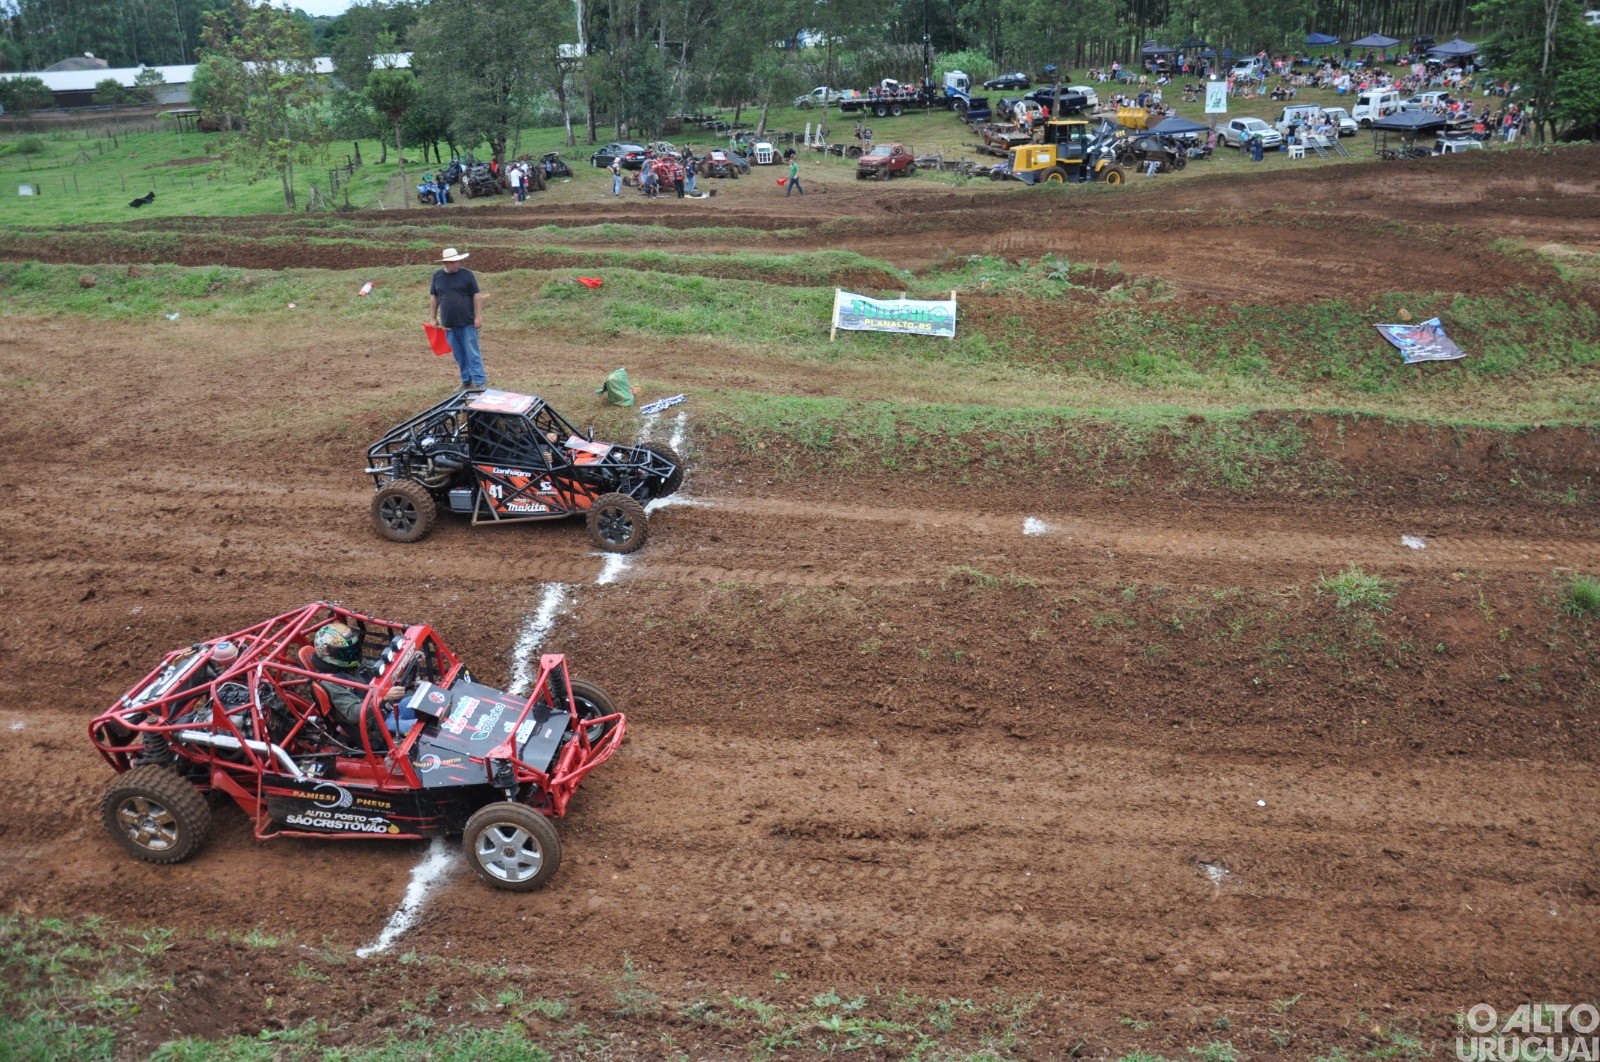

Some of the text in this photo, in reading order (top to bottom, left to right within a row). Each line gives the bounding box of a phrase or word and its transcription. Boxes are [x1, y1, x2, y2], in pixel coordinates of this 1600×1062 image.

[489, 485, 503, 498] 41
[356, 797, 392, 809] PNEUS
[305, 809, 366, 822] AUTO POSTO
